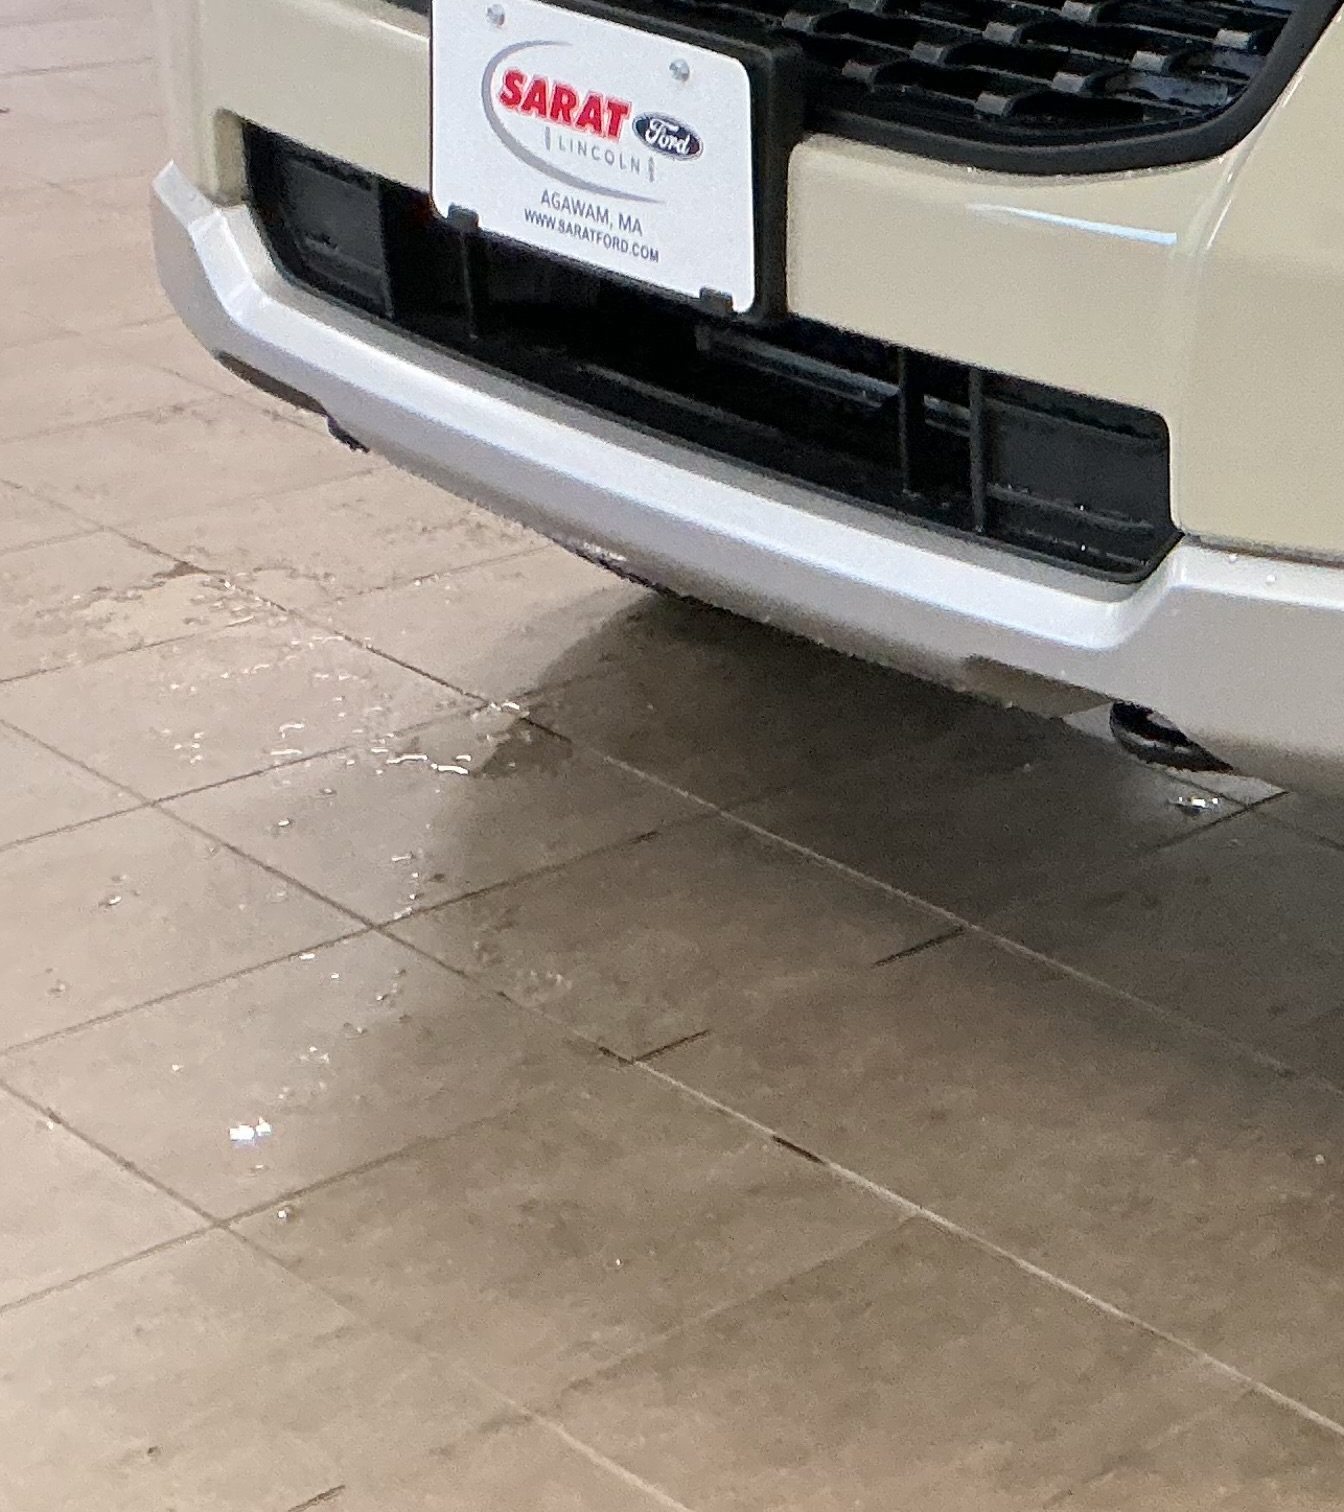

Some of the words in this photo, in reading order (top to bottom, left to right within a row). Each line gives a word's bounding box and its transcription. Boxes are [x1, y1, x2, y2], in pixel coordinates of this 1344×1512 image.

[499, 68, 633, 143] SARAT
[558, 134, 641, 175] LINCOLN
[644, 117, 692, 157] Ford
[524, 207, 660, 264] WWW.SARATFORD.COM
[541, 189, 614, 231] AGAWAM,
[618, 212, 643, 236] MA
